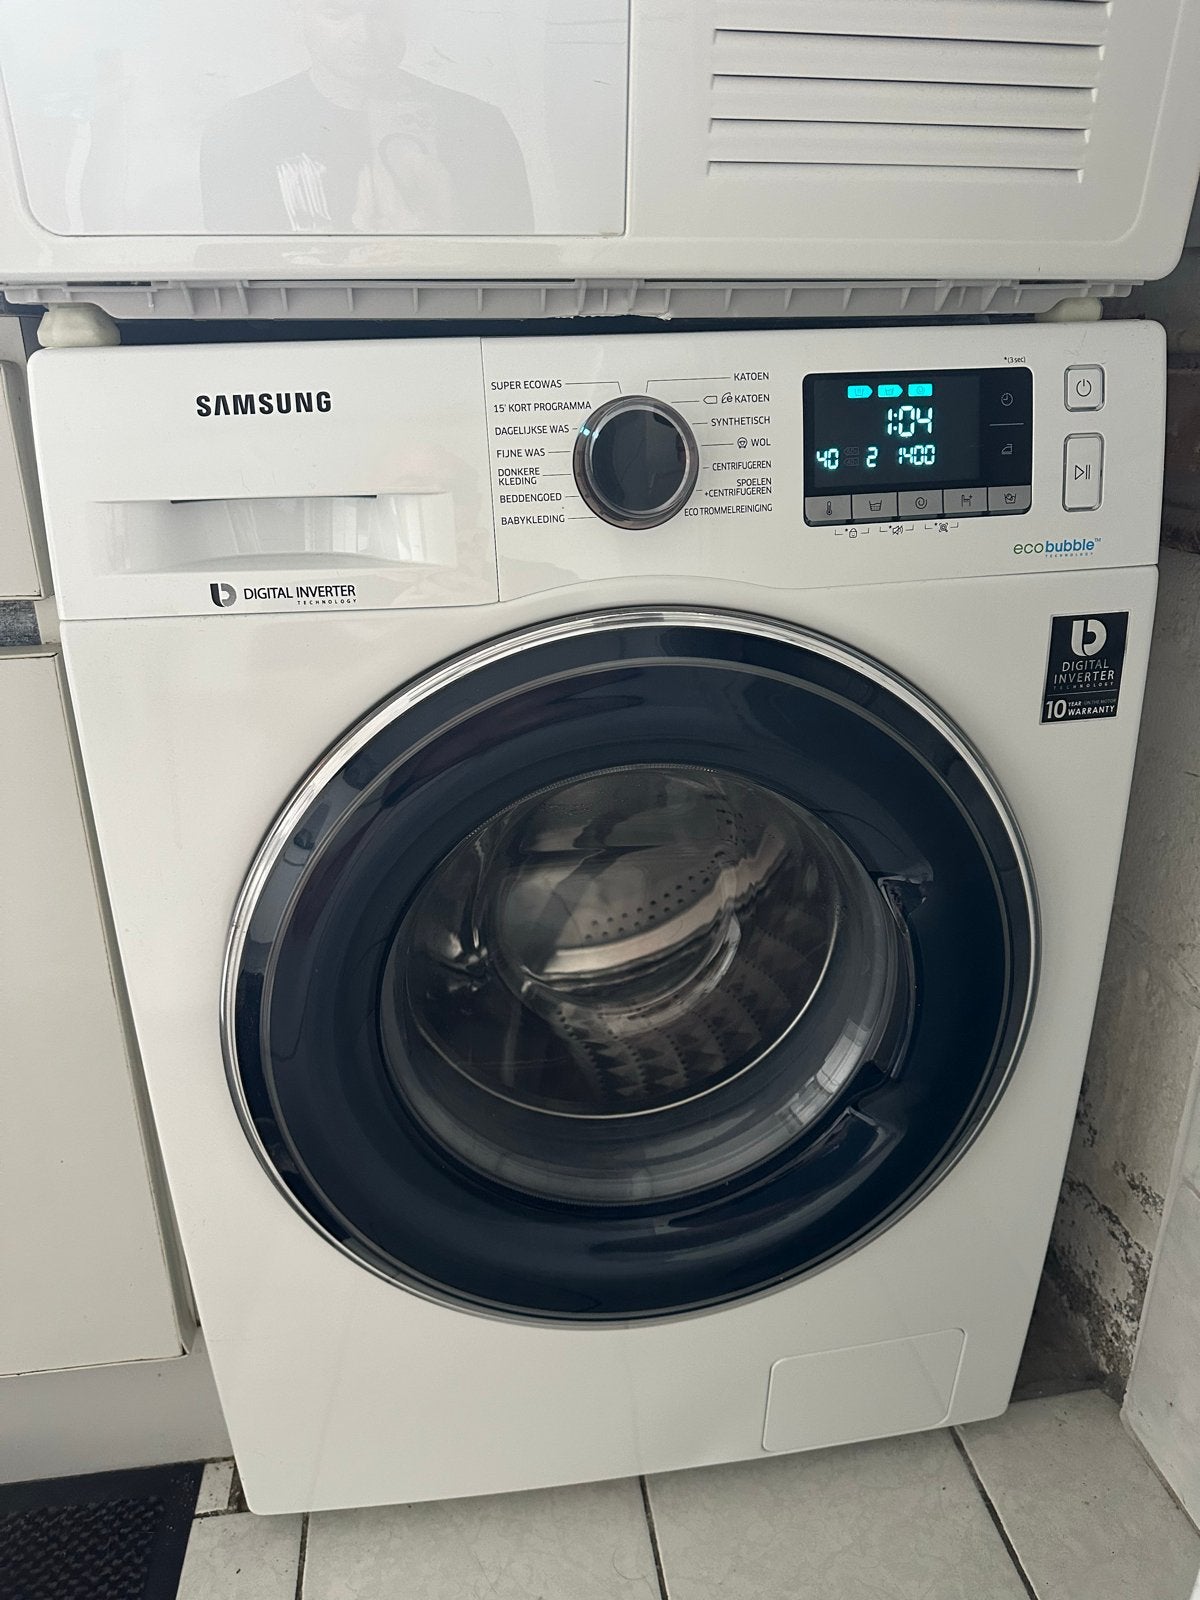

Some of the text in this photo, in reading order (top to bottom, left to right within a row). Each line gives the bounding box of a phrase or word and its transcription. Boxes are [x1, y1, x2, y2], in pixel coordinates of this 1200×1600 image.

[733, 372, 769, 381] KATOEN
[491, 379, 562, 391] SUPER ECOWAS
[196, 391, 332, 417] SAMSUNG
[734, 394, 770, 403] KATOEN
[508, 403, 532, 412] KORT
[534, 401, 592, 411] PROGRAMMA
[711, 416, 771, 427] SYNTHETISCH
[887, 405, 933, 437] 1:04
[495, 425, 570, 436] DAGELIJKSE WAS
[751, 438, 771, 446] WOL
[496, 448, 546, 458] FIJNE WAS
[866, 446, 878, 468] 2
[898, 444, 936, 466] 1400
[816, 448, 839, 470] 40
[712, 460, 772, 471] CENTRIFUGEREN
[498, 467, 540, 477] DONKERE
[498, 476, 537, 486] KLEDING
[736, 477, 772, 487] SPOELEN
[500, 493, 562, 504] BEDDENGOED
[684, 503, 773, 517] ECO TROMMELREINIGING
[501, 514, 565, 526] BABYKLEDING
[243, 587, 293, 600] DIGITAL
[296, 584, 356, 598] INVERTER
[1062, 659, 1109, 672] DIGITAL
[1053, 670, 1115, 685] INVERTER
[1045, 699, 1067, 719] 10
[1068, 705, 1115, 716] WARRANTY
